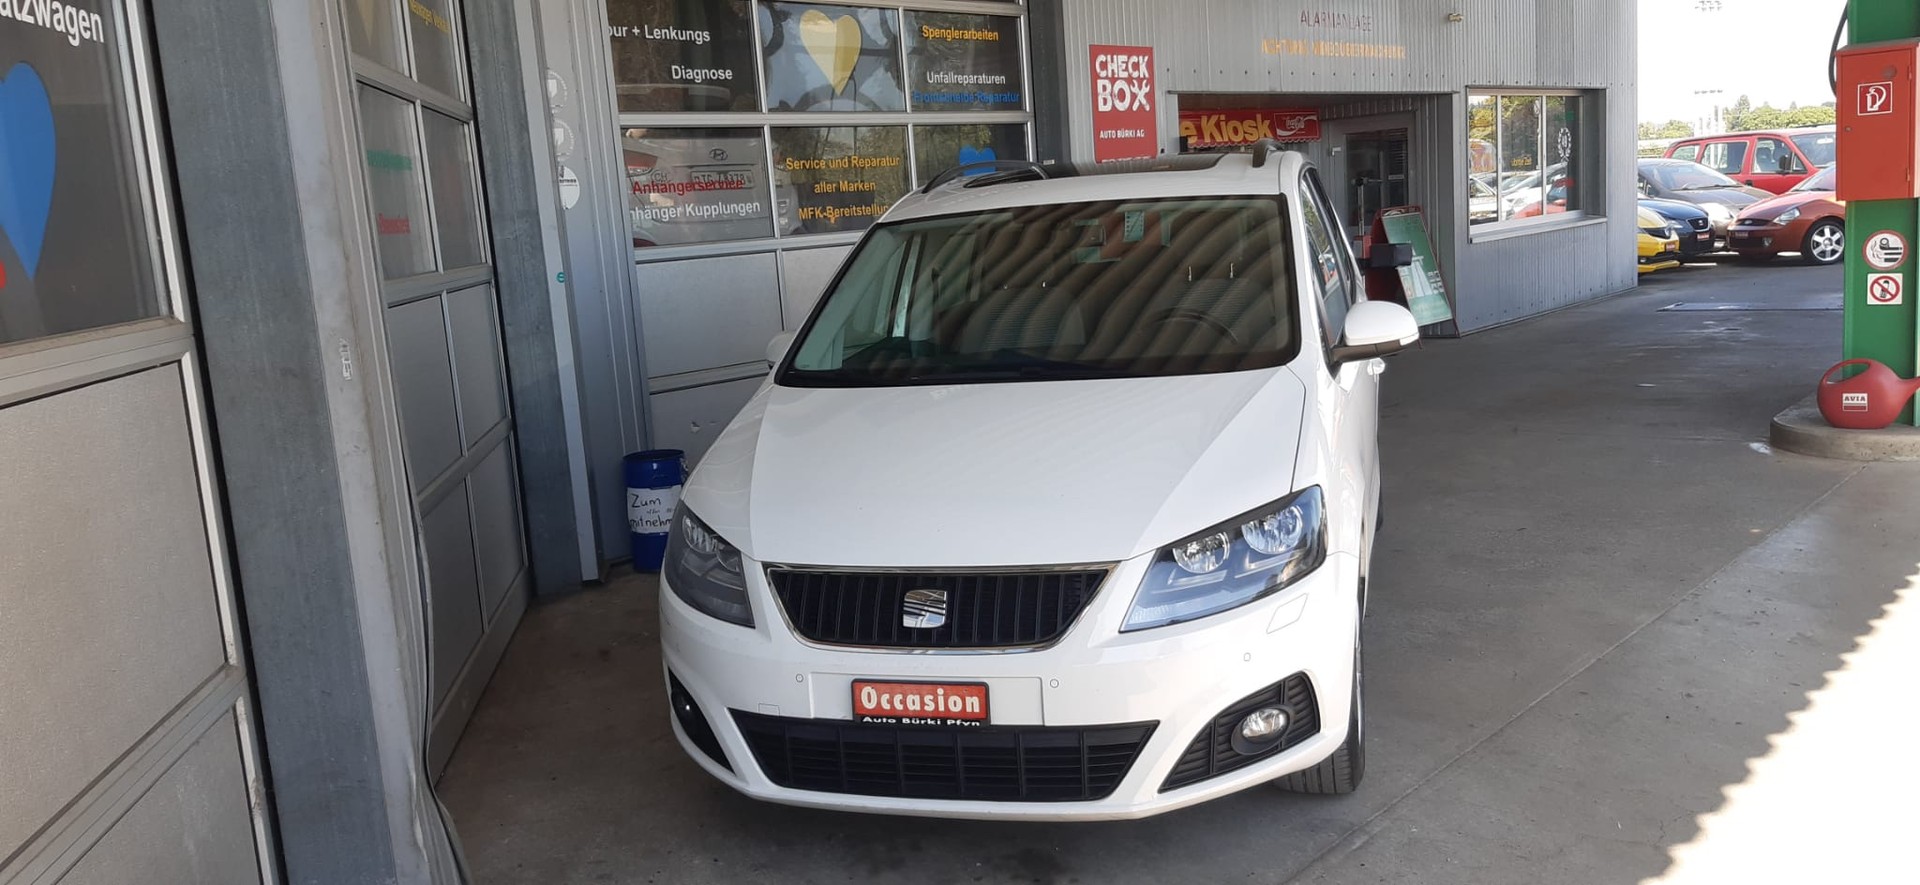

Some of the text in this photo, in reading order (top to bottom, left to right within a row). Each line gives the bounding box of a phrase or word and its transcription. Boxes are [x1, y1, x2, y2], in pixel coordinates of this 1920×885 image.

[1300, 10, 1372, 32] ALARMANLAGE
[644, 24, 711, 45] Lenkungs
[922, 25, 999, 41] Spenglerarbeiten
[671, 65, 733, 83] Diagnose
[1095, 54, 1149, 78] CHECK
[926, 71, 1006, 86] Unfallreparaturen
[1097, 79, 1151, 112] BOX
[1100, 129, 1145, 139] AUTO BÜRKI AG
[1201, 113, 1274, 143] Kiosk
[786, 155, 900, 170] Service und Reparatur
[814, 181, 876, 194] aller Marken
[685, 202, 760, 219] Kupplungen
[631, 493, 661, 508] Zum
[860, 686, 980, 713] Occasion
[901, 717, 941, 725] Bürki
